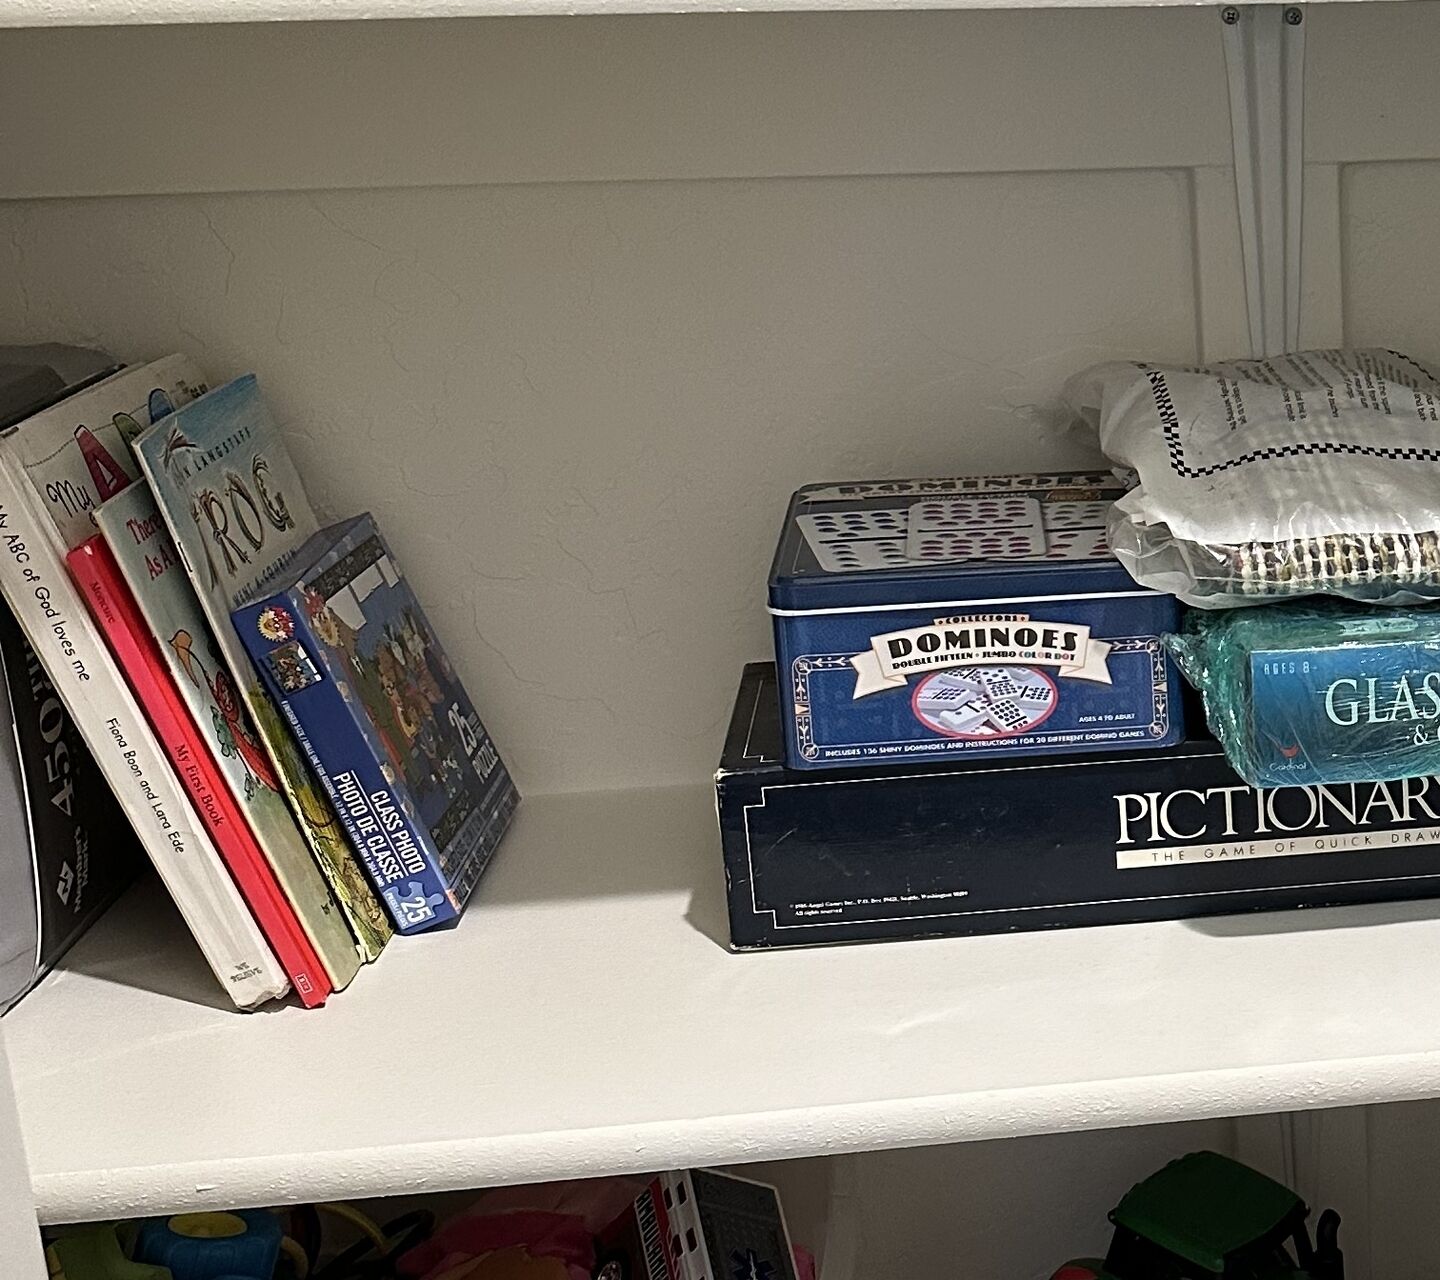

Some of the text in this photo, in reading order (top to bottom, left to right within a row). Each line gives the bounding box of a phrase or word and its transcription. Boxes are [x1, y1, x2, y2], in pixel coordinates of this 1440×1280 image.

[2, 535, 30, 563] ABC
[23, 567, 42, 583] of
[34, 586, 60, 618] God
[51, 620, 76, 657] loves
[72, 659, 90, 682] me
[887, 627, 1078, 659] DOMINOES
[892, 657, 933, 670] DOUBLE
[934, 652, 973, 663] FIFTEEN
[1018, 651, 1052, 659] COLOR
[1054, 653, 1076, 661] DOT
[1264, 662, 1296, 676] AGES
[1079, 715, 1097, 723] AGES
[825, 749, 861, 757] INCLUDES
[879, 746, 902, 754] SHINY
[904, 744, 945, 752] DOMINOES
[947, 742, 964, 750] AND
[965, 738, 1018, 748] INSTRUCTIONS
[1020, 737, 1034, 745] FOR
[1047, 734, 1085, 743] DIFFERENT
[1085, 732, 1117, 741] DOMINO
[1118, 730, 1145, 738] GAMES
[1413, 723, 1429, 746] &
[106, 717, 185, 854] Fiona Boon and Lara Ede
[175, 744, 224, 828] My First Book
[333, 771, 367, 818] PHOTO
[357, 815, 379, 837] DE
[370, 790, 404, 829] CLASS
[397, 825, 426, 874] PHOTO
[367, 833, 404, 884] CLASSE
[1152, 850, 1185, 863] THE
[1204, 844, 1256, 859] GAME
[1274, 841, 1297, 853] OF
[1315, 836, 1372, 850] QUICK
[400, 896, 436, 924] 25
